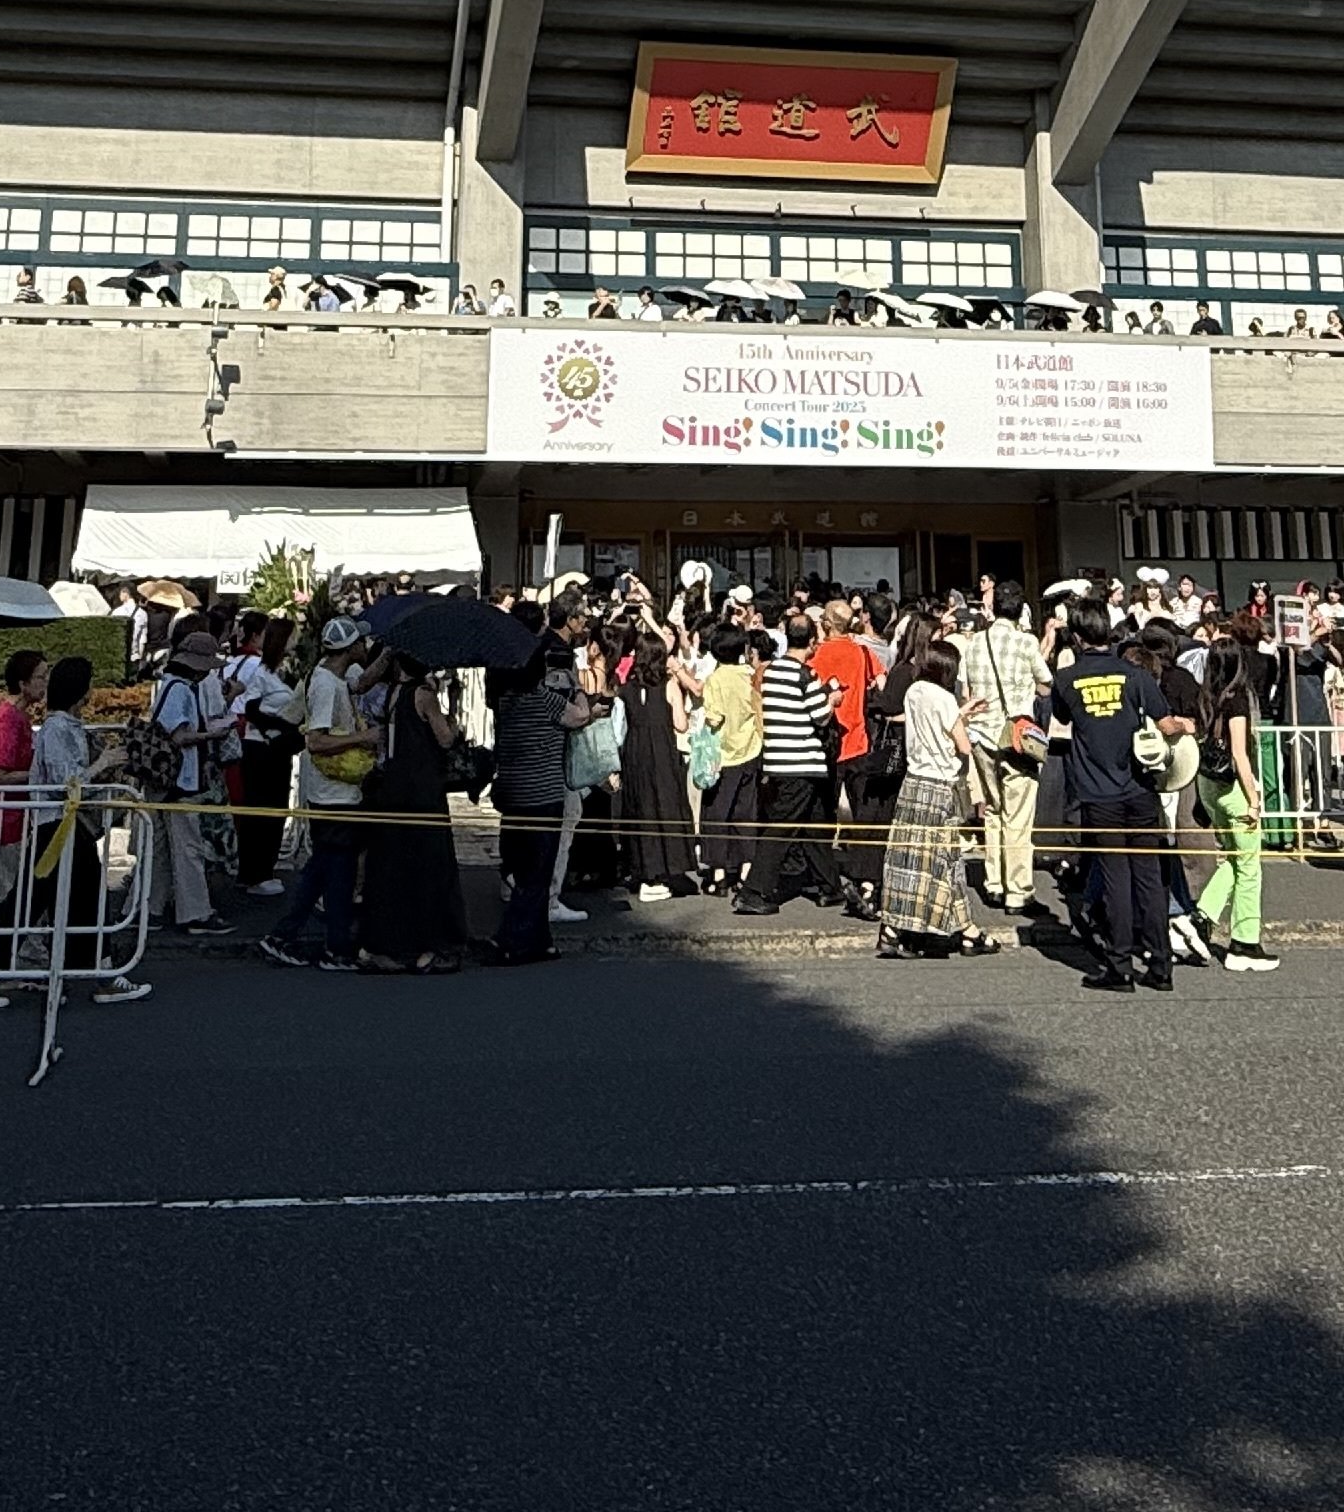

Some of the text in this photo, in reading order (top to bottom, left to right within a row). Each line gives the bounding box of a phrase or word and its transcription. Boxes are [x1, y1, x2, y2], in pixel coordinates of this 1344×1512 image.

[783, 344, 874, 365] Anniversary
[996, 354, 1074, 371] 日本武道館
[683, 366, 924, 397] SEIKO MATSUDA
[1064, 379, 1096, 391] 17:30
[1136, 381, 1168, 392] 18:30
[744, 399, 867, 413] Concert Tour 2025
[1064, 396, 1096, 408] 15:00
[1137, 398, 1168, 409] 16:00
[662, 414, 945, 459] Sing! Sing! Sing!
[542, 439, 614, 453] Anniversary
[1081, 684, 1122, 704] STAFF
